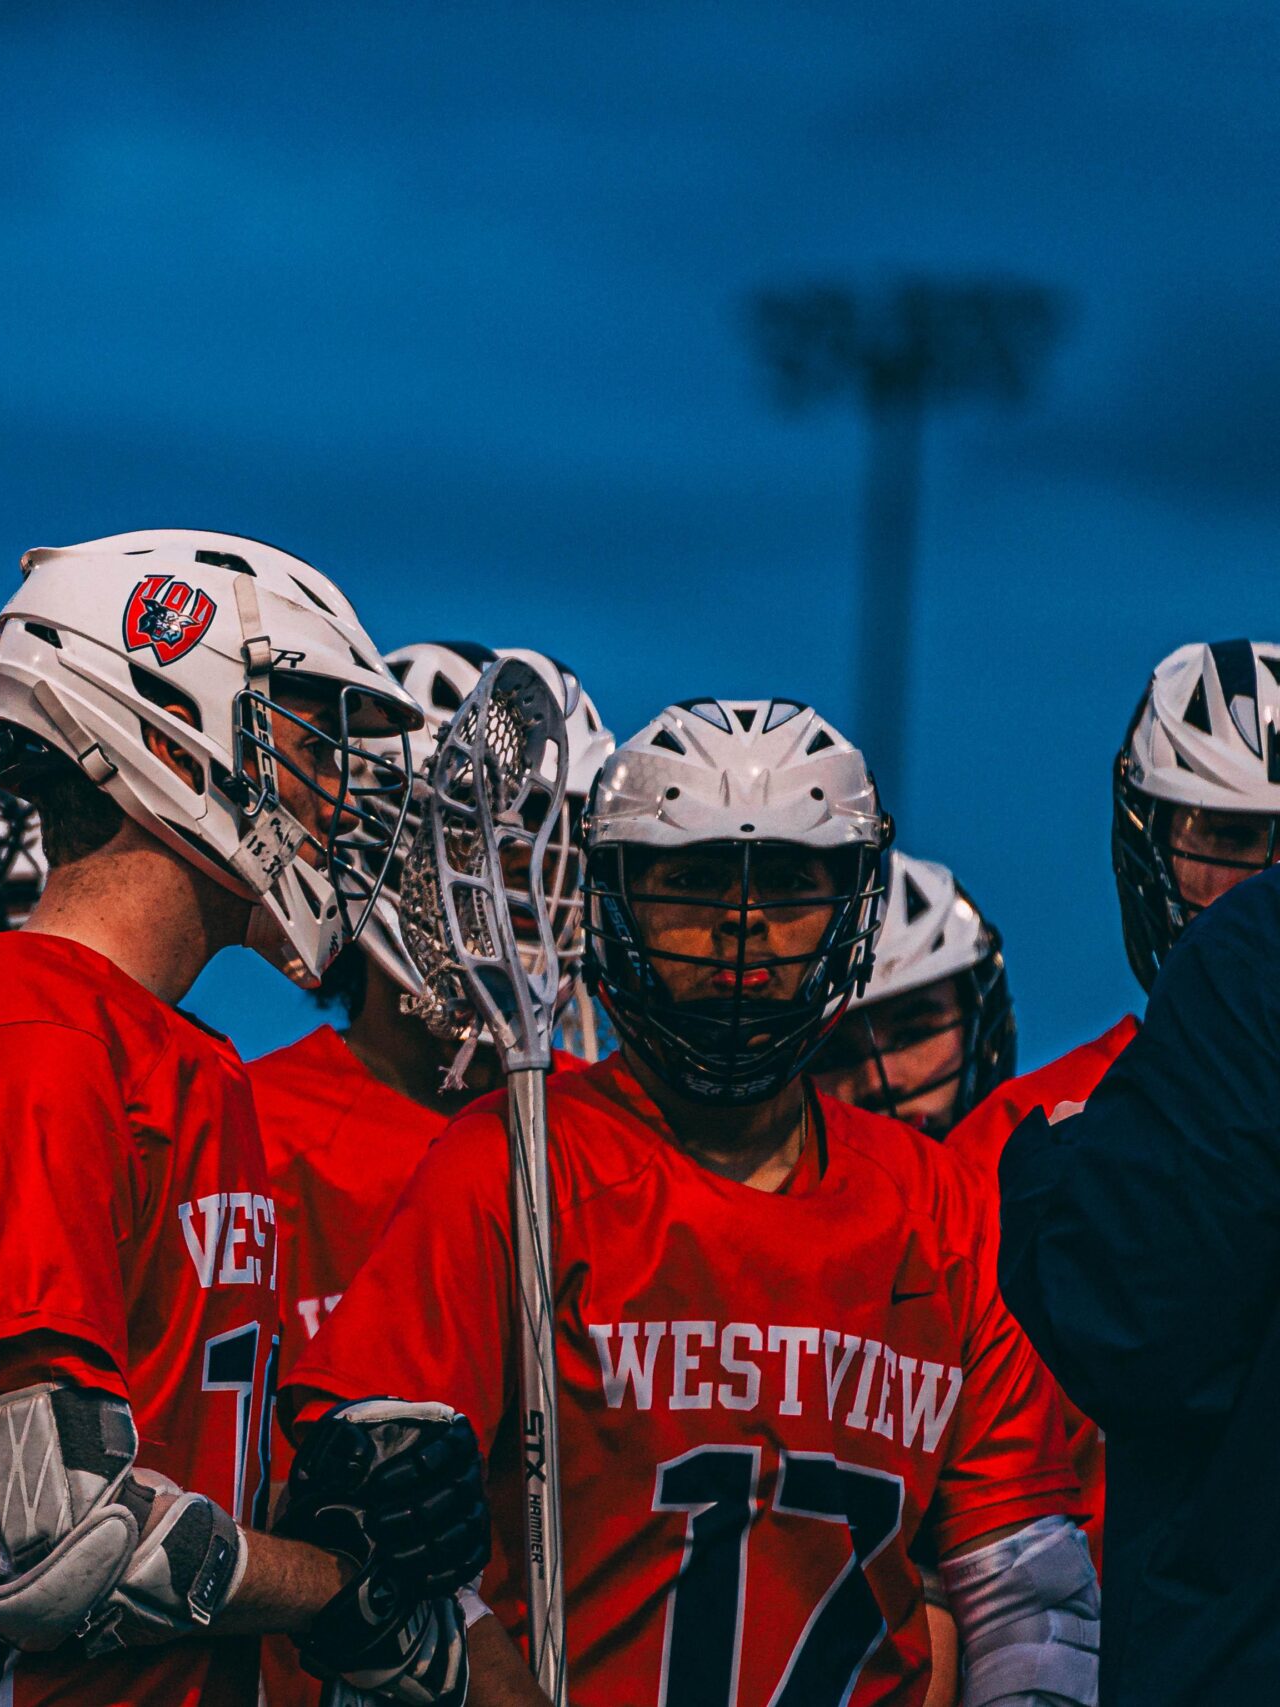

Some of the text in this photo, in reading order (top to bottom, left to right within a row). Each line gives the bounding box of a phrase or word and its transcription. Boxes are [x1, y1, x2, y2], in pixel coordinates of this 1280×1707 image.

[588, 1320, 964, 1455] WESTVIEW
[522, 1408, 546, 1565] STX HAMMER
[650, 1444, 907, 1707] 17
